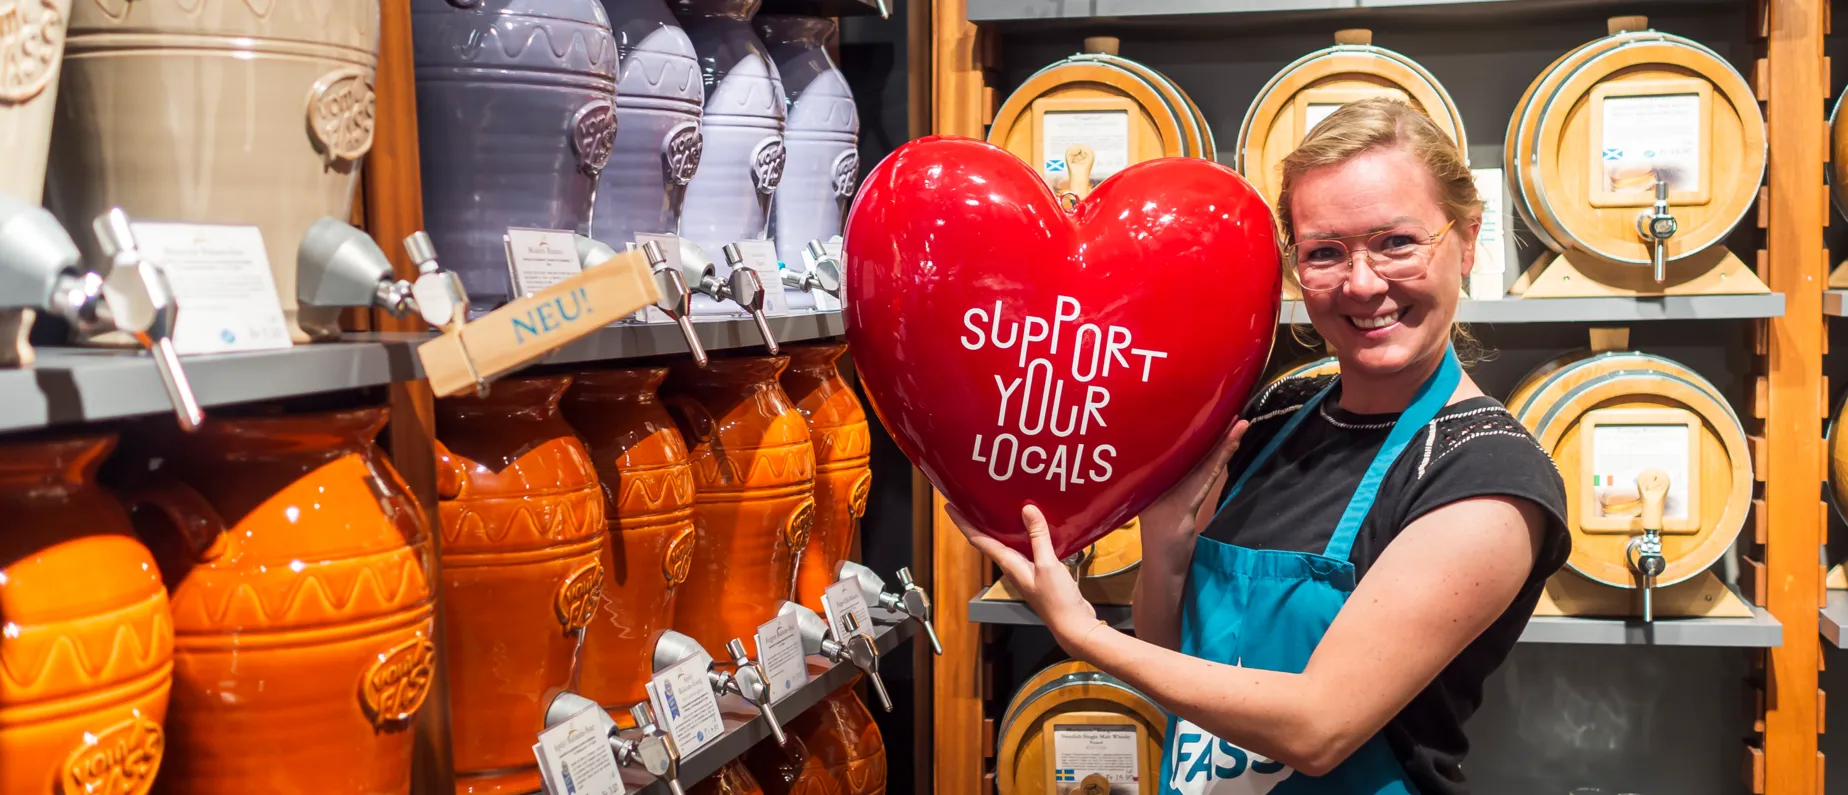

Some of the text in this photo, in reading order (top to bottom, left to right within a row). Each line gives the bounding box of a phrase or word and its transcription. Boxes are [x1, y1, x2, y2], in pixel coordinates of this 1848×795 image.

[511, 287, 594, 344] NEU!
[960, 295, 1168, 382] SUPPORT
[994, 358, 1110, 437] YOUR
[971, 433, 1117, 491] LOCALS
[1172, 733, 1285, 783] FAS
